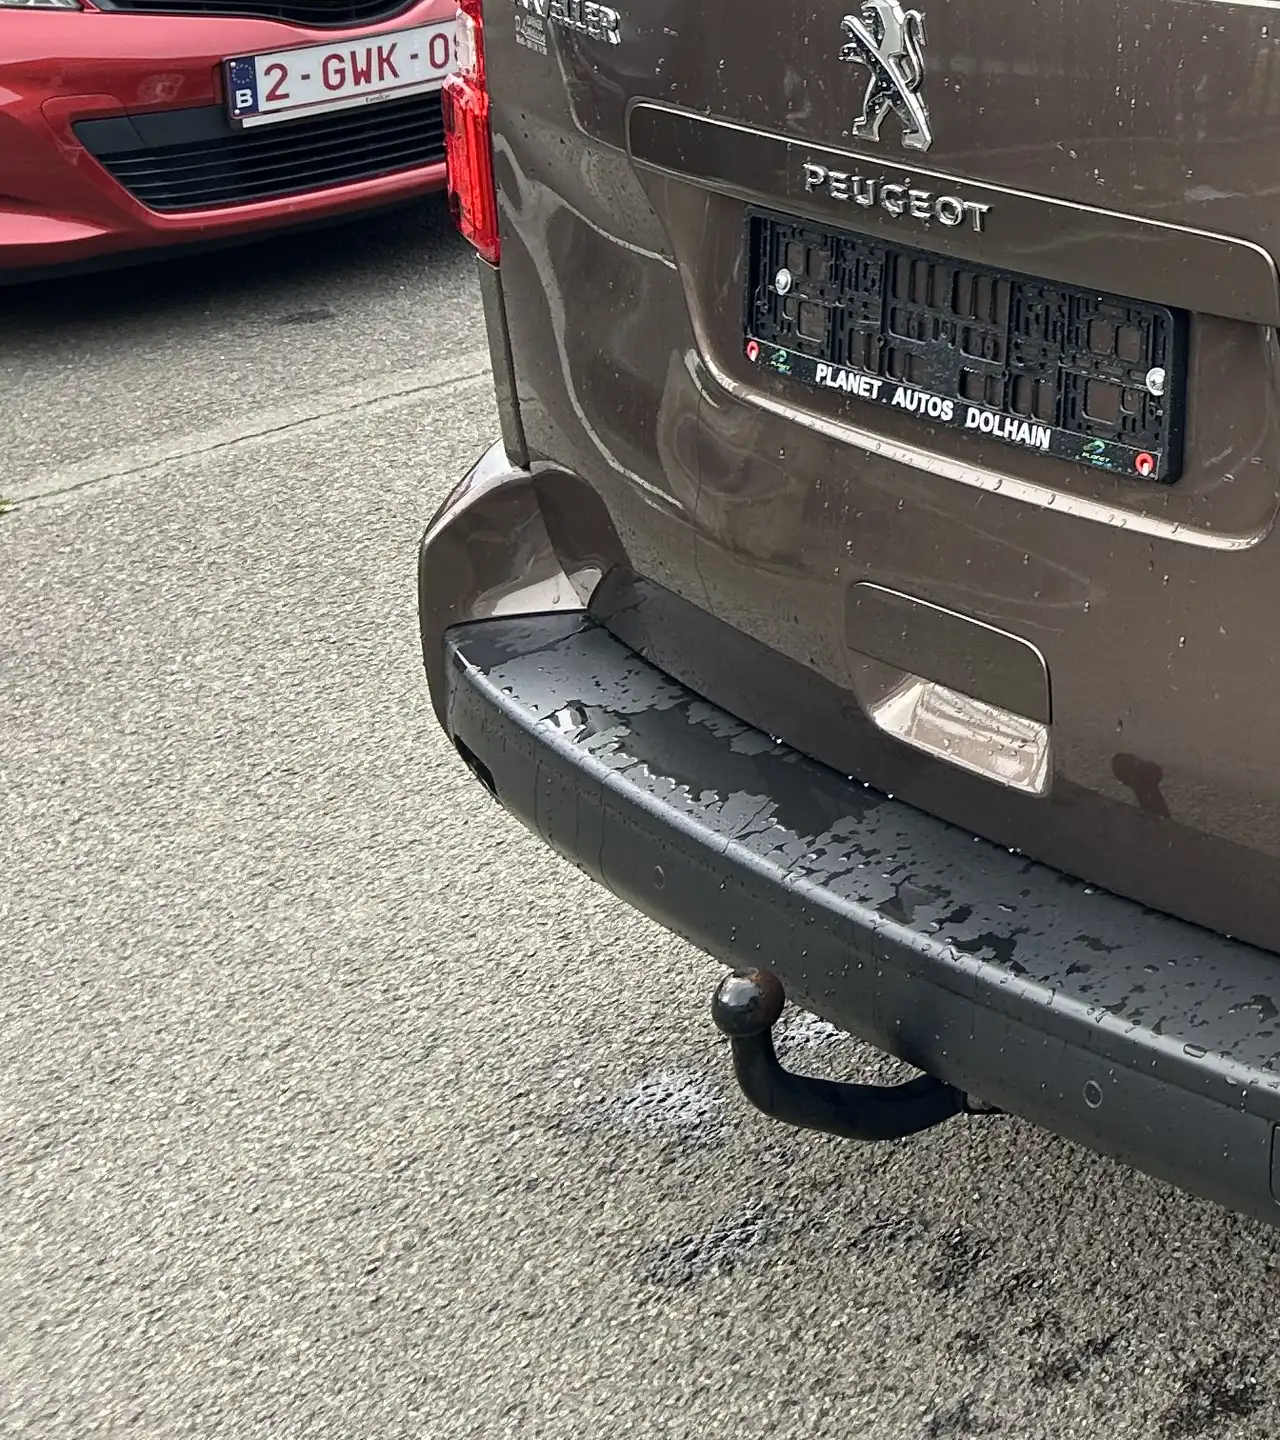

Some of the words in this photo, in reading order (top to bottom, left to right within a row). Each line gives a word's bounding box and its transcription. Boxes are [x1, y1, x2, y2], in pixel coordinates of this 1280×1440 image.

[236, 89, 253, 108] B
[264, 32, 458, 102] 2-GWK-0
[802, 162, 993, 232] PEUGEOT
[815, 363, 882, 399] PLANET
[892, 387, 954, 421] AUTOS
[965, 407, 1051, 449] DOLHAIN
